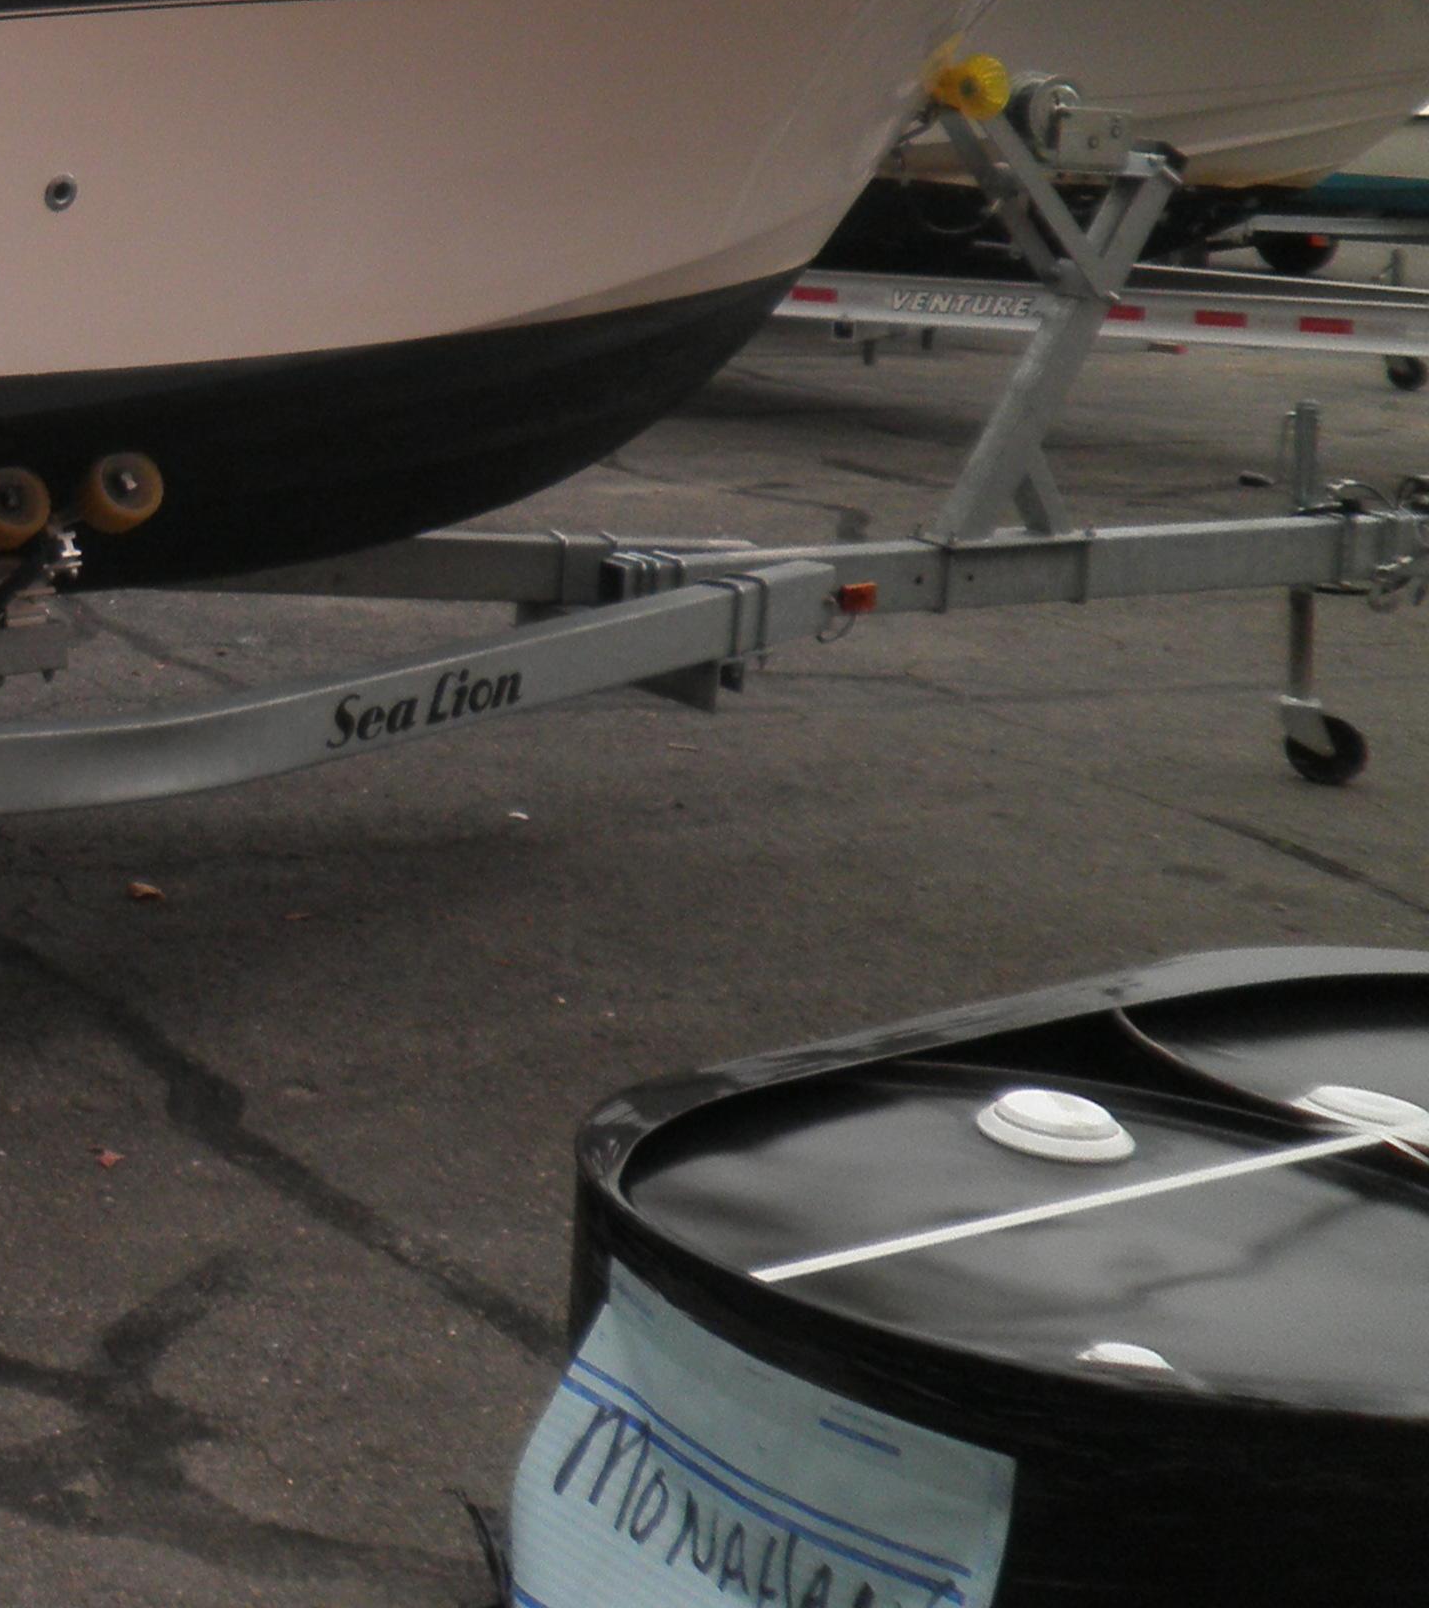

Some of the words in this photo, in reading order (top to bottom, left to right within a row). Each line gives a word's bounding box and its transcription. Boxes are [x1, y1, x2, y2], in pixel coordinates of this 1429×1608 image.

[891, 289, 1035, 318] VENTURE
[326, 693, 419, 749] Sea
[425, 668, 524, 726] Lion
